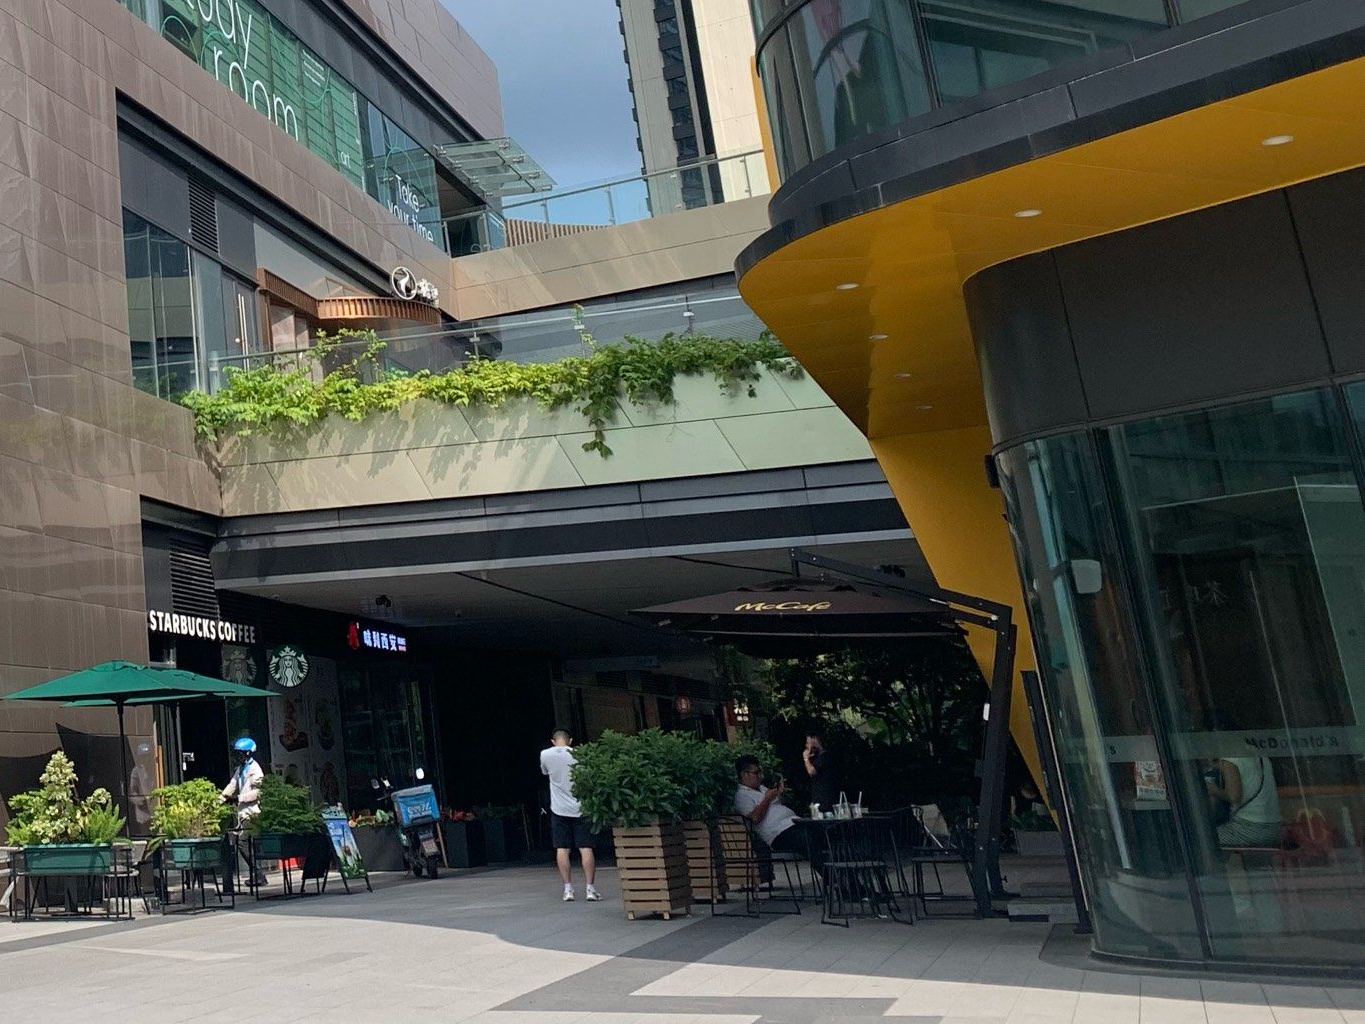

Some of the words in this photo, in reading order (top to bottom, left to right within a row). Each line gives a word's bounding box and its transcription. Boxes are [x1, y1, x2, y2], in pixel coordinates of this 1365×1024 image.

[395, 174, 420, 213] Take
[149, 609, 216, 641] STARBUCKS
[217, 620, 256, 644] COFFEE
